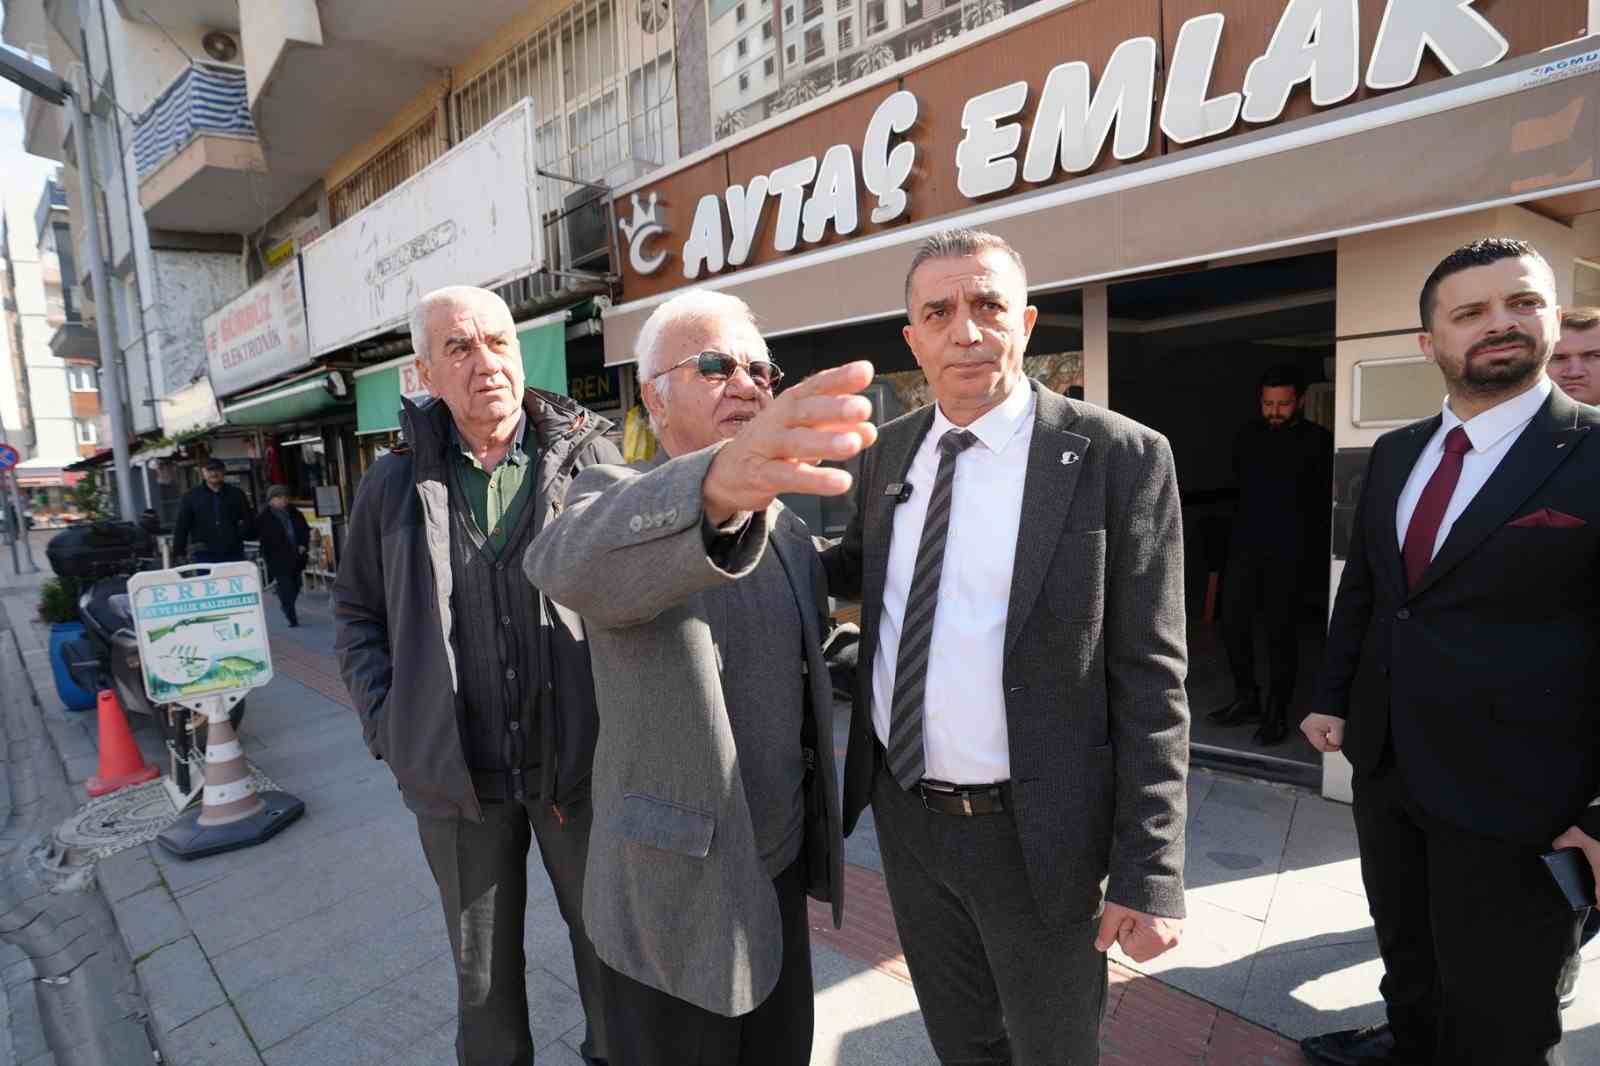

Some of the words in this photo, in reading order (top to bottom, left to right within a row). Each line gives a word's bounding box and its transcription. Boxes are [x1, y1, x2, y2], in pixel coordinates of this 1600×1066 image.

[682, 91, 919, 279] AYTAÇ
[956, 0, 1510, 198] EMLAK
[153, 577, 242, 601] EREN
